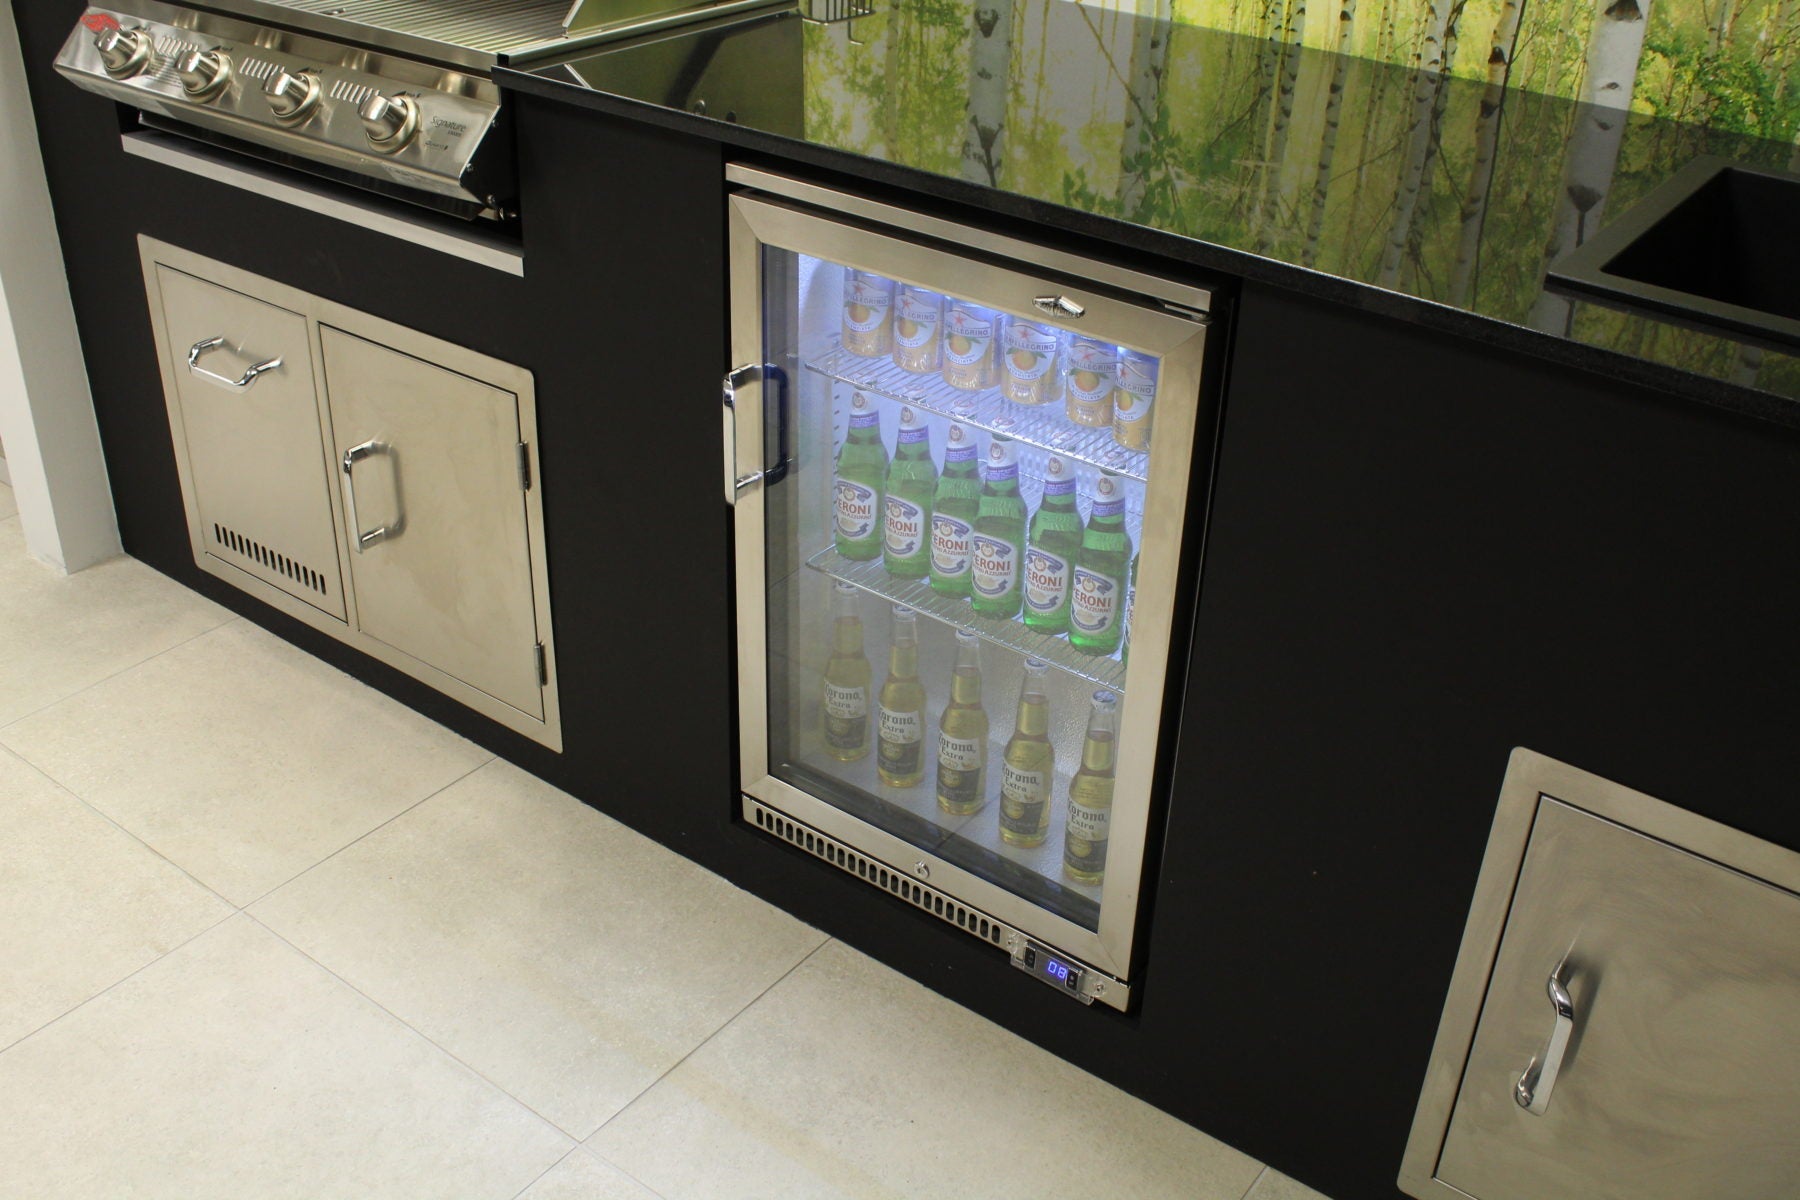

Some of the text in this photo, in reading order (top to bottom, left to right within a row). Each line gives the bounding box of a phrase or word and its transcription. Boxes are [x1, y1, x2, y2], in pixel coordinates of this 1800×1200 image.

[837, 497, 871, 514] ERONI
[886, 514, 917, 532] ERONI
[932, 532, 969, 551] ERONI
[1026, 567, 1062, 587] ERONI
[1047, 960, 1067, 979] 08
